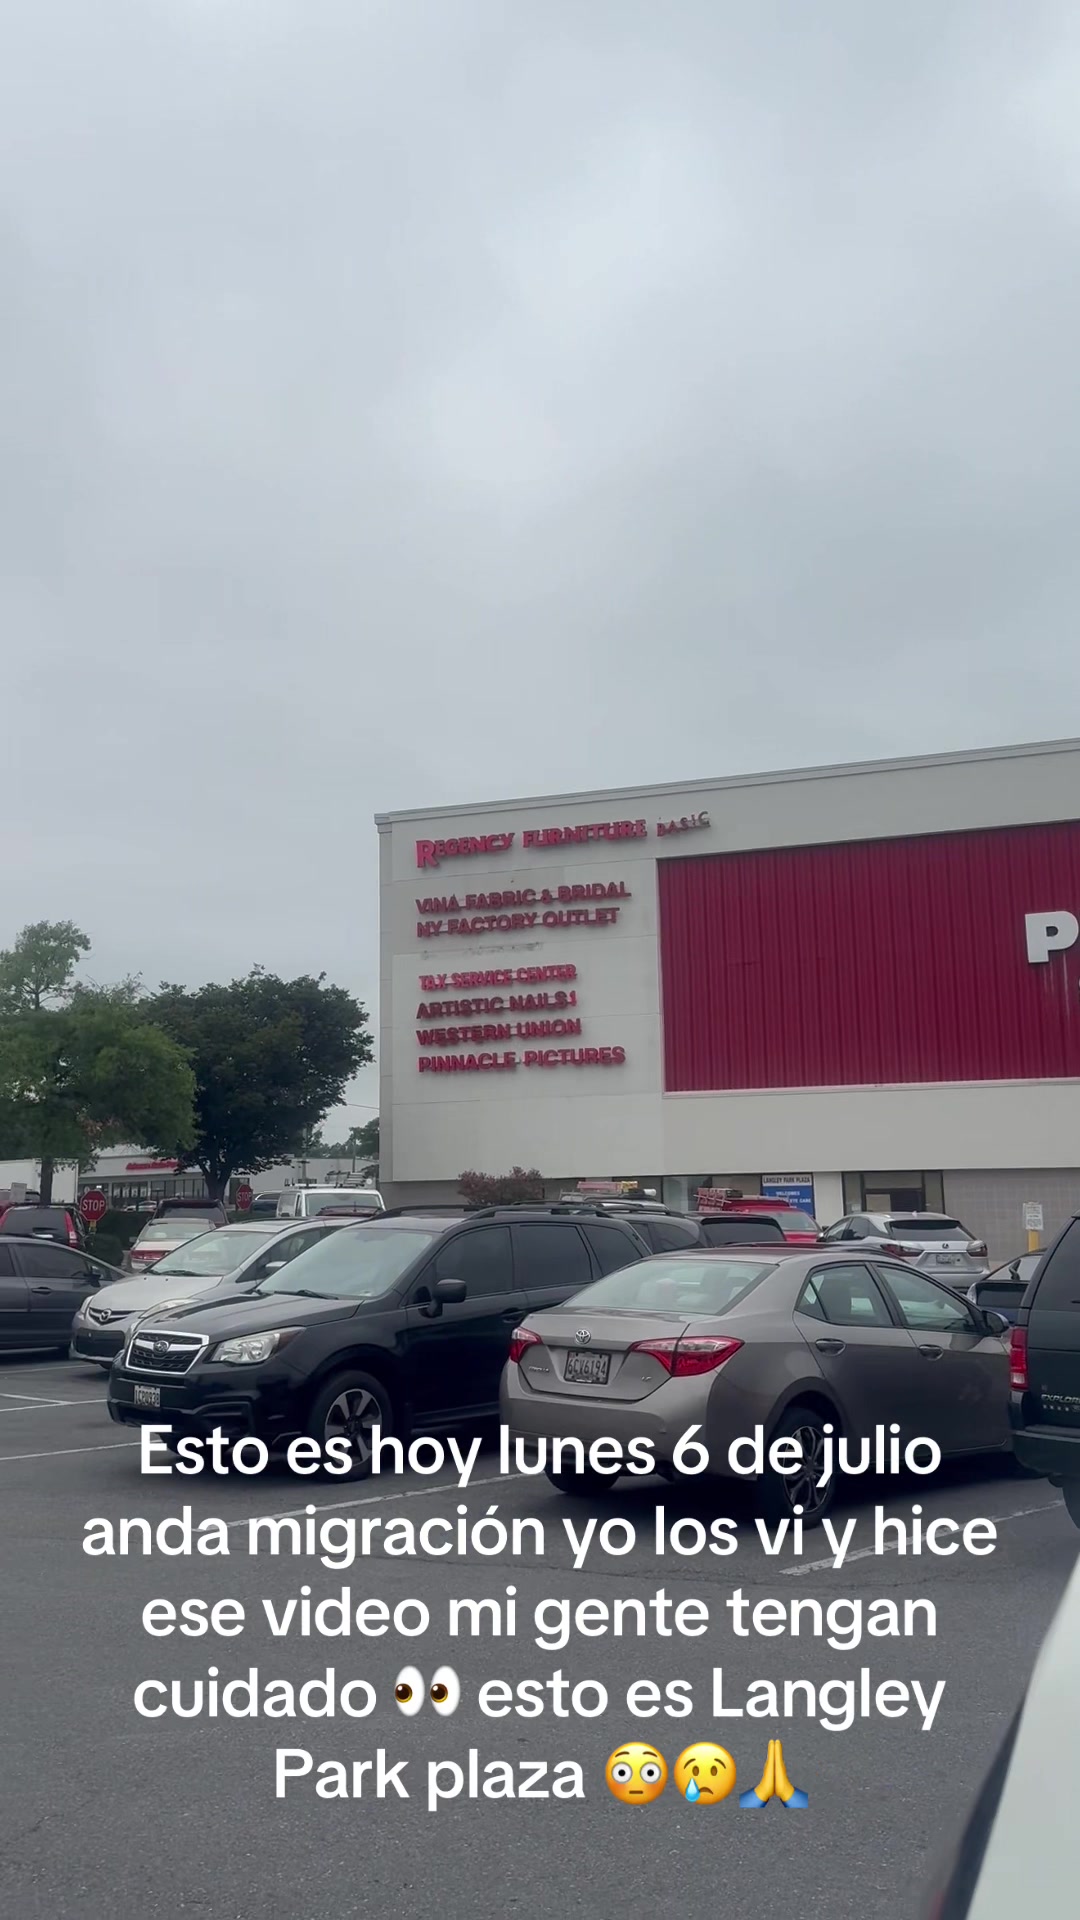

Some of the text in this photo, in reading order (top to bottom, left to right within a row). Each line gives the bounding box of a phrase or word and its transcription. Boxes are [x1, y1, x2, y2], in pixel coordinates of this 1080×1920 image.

[416, 833, 515, 868] REGENCY
[523, 819, 647, 848] FURNITURE
[415, 881, 632, 914] VINA FABRIC & BRIDAL
[417, 907, 620, 938] NY FACTORY OUTLET
[419, 964, 578, 991] TAX SERVICE CENTER
[416, 996, 504, 1019] ARTISTIC
[416, 1018, 582, 1046] WESTERN UNION
[418, 1046, 626, 1072] PINNACLE PICTURES
[763, 1175, 811, 1184] LANGLEY PARK PLAZA
[82, 1199, 105, 1211] STOP
[237, 1191, 253, 1203] STOP
